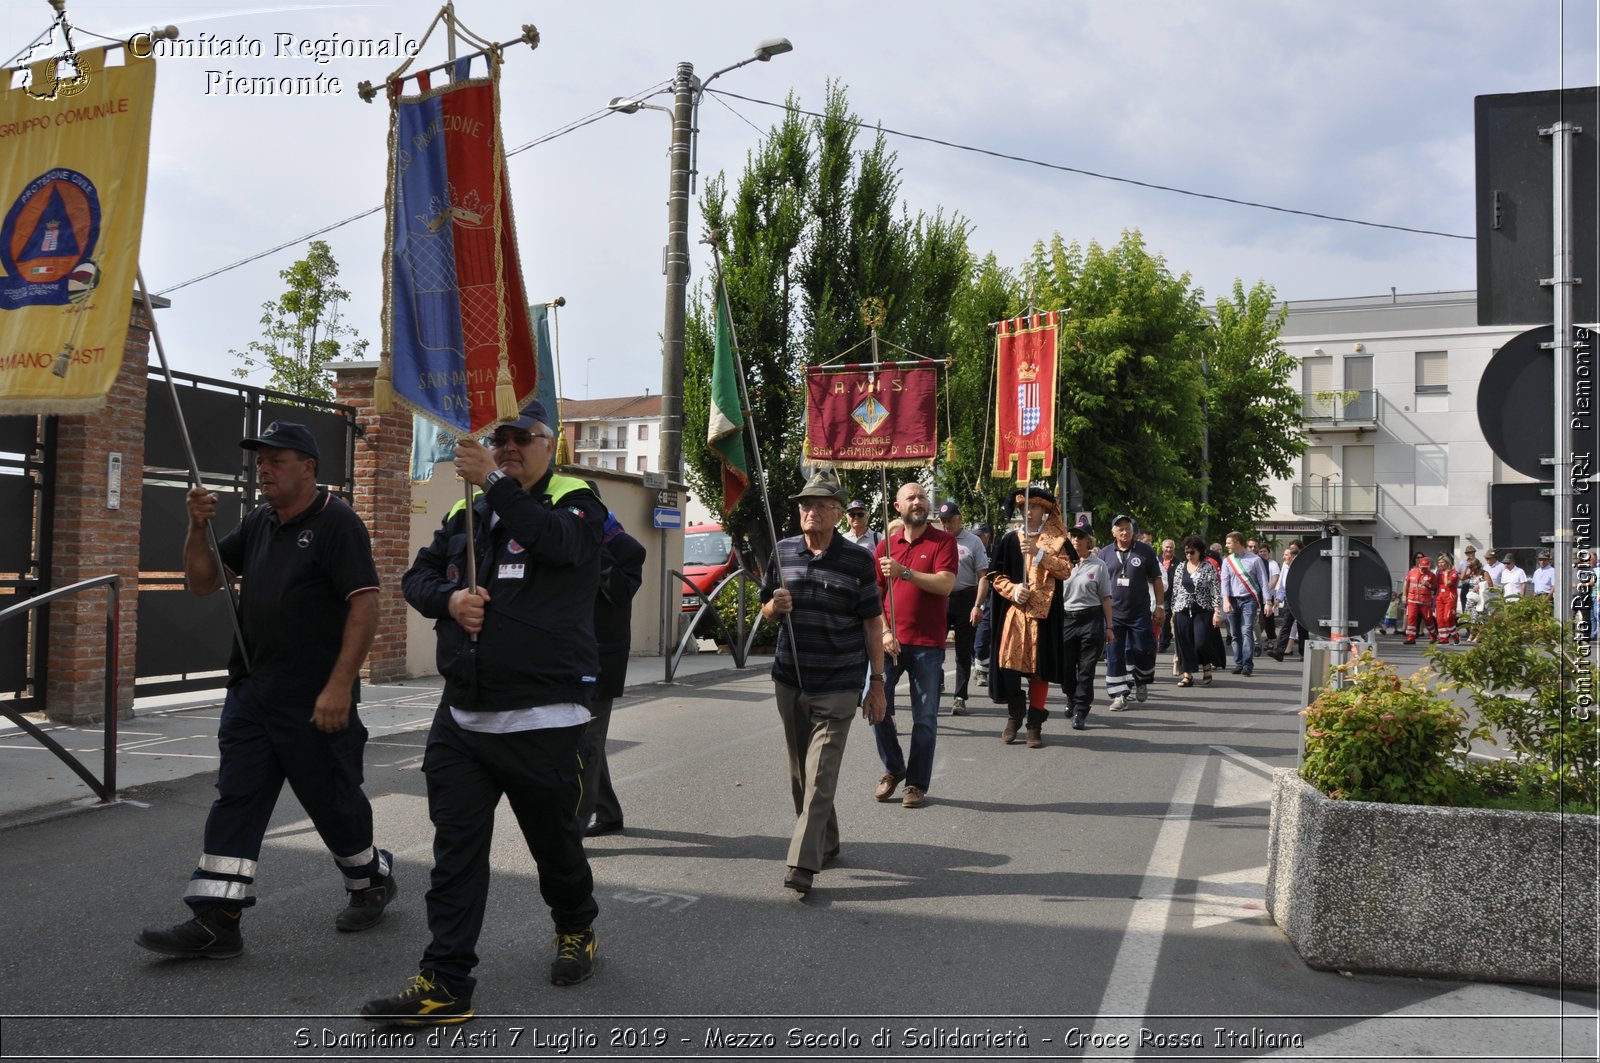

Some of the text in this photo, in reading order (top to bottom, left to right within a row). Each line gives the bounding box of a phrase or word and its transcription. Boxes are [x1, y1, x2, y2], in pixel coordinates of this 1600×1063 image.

[0, 115, 50, 137] GRUPPO
[418, 364, 517, 391] SAN DAMIAO
[813, 446, 833, 456] SAN
[839, 446, 884, 457] DAMIANO
[905, 444, 930, 455] ASTI
